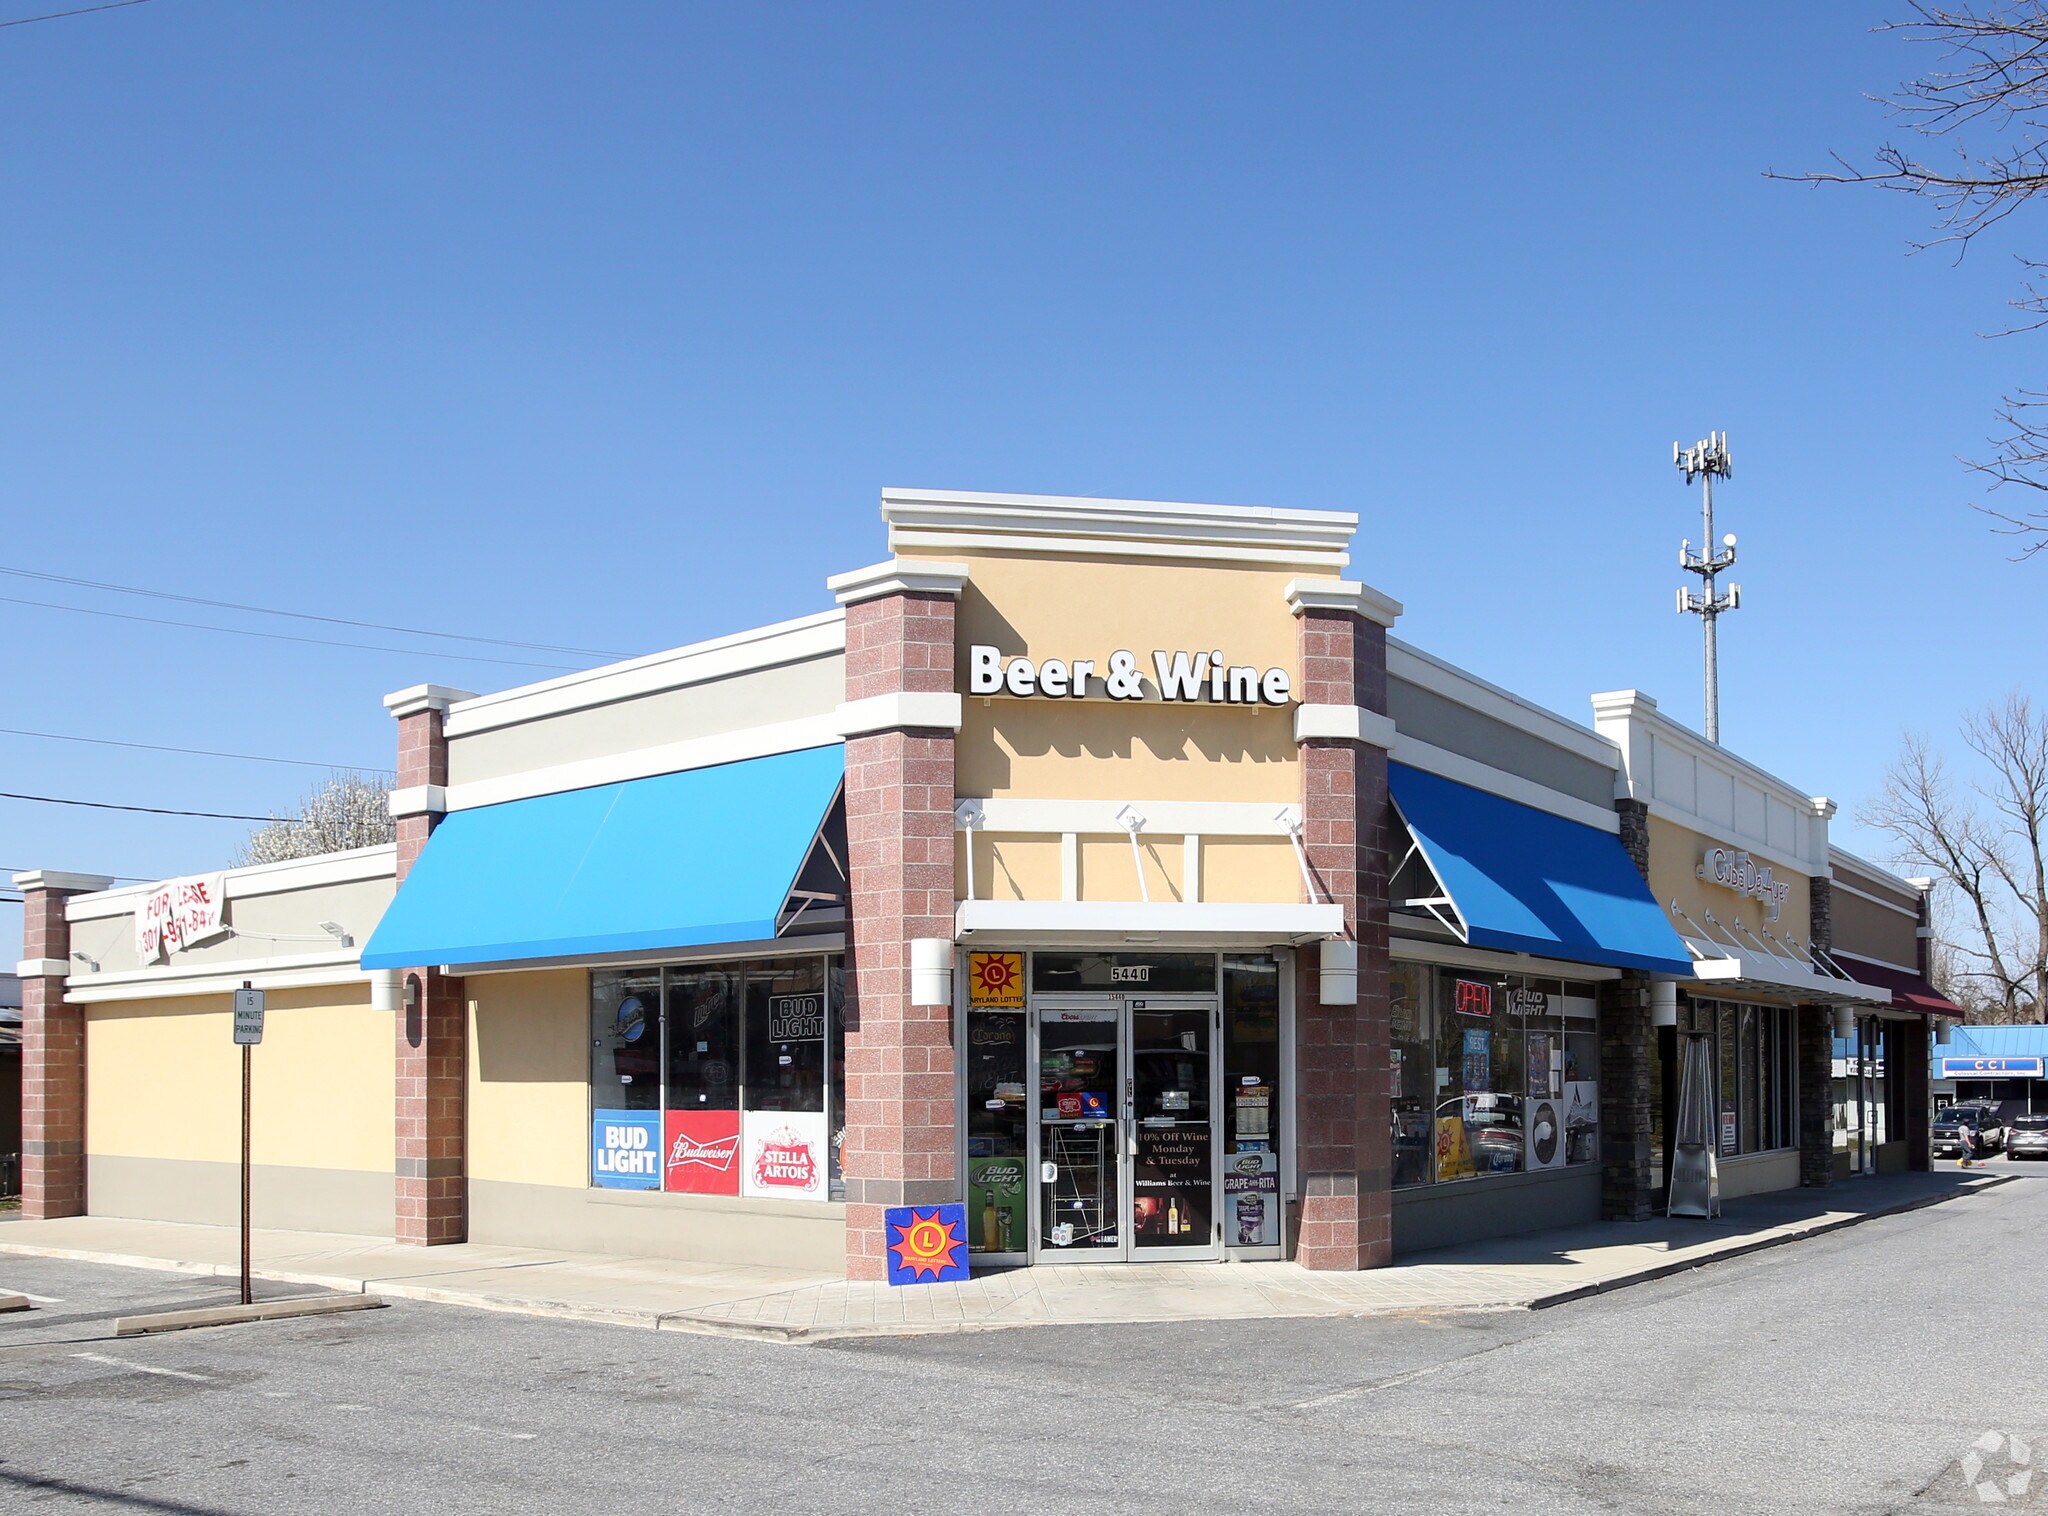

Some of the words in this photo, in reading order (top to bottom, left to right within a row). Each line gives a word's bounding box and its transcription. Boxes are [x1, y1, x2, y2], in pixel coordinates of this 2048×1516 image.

[970, 644, 1095, 698] Beer
[1105, 649, 1144, 701] &
[1152, 649, 1292, 706] Wine
[1713, 848, 1744, 888] Cuba
[146, 892, 169, 921] FOR
[992, 969, 1000, 979] L
[1112, 968, 1147, 980] 5440
[246, 997, 254, 1005] 15
[1457, 981, 1491, 1016] OPEN
[1516, 990, 1543, 1003] BUD
[780, 998, 818, 1018] BUD
[1510, 1003, 1545, 1016] LIGHT
[237, 1010, 262, 1020] MINUTE
[235, 1024, 263, 1034] PARKING
[772, 1017, 824, 1038] LIGHT
[971, 1028, 1012, 1043] Corona
[1974, 1060, 2006, 1070] CCI
[605, 1125, 648, 1150] BUD
[1140, 1133, 1160, 1141] 10%
[1162, 1132, 1180, 1141] Off
[1182, 1132, 1208, 1141] Wine
[672, 1141, 733, 1160] Budweiser
[1152, 1144, 1195, 1155] Monday
[765, 1150, 809, 1165] STELLA
[1146, 1156, 1156, 1165] &
[1159, 1156, 1200, 1167] Tuesday
[764, 1165, 809, 1180] ARTOIS
[986, 1165, 1018, 1176] BUD
[978, 1174, 1022, 1184] LIGHT
[922, 1231, 934, 1248] L
